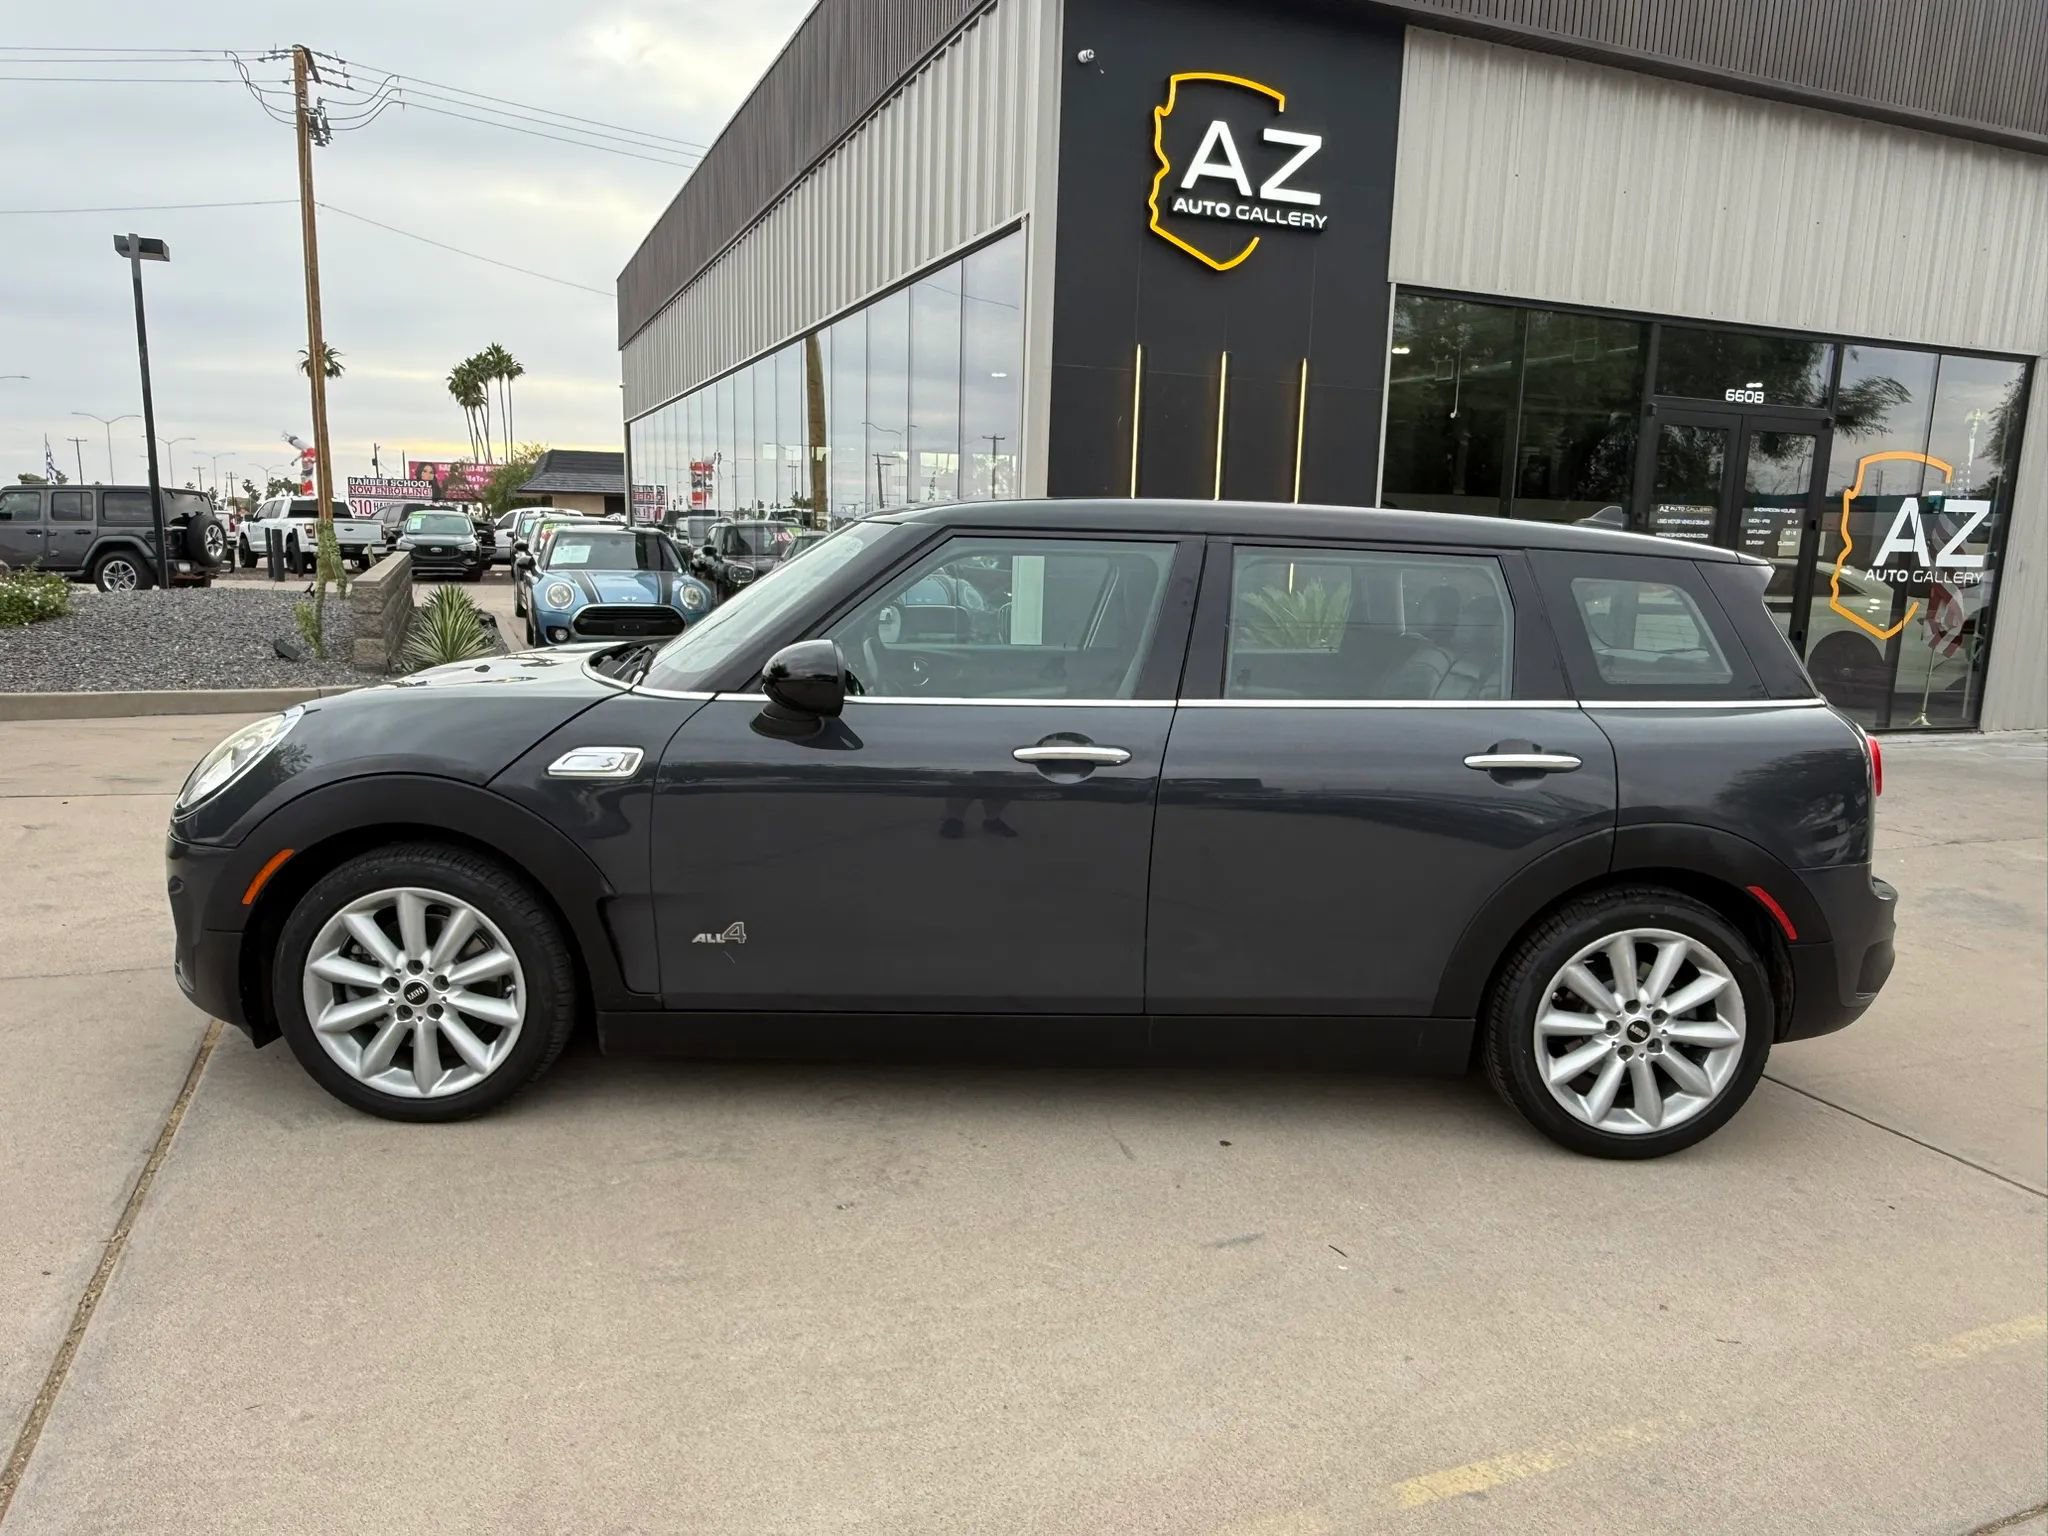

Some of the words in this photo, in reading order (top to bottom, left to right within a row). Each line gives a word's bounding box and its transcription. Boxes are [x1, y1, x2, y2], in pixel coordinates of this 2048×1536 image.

[1180, 120, 1322, 206] AZ
[1173, 198, 1231, 217] AUTO
[1235, 205, 1328, 229] GALLERY
[1725, 388, 1765, 403] 6608
[349, 478, 389, 486] BARBER
[390, 480, 432, 488] SCHOOL
[350, 486, 373, 495] NOW
[350, 500, 372, 515] $10
[1659, 505, 1669, 513] AZ
[1872, 497, 1991, 568] AZ
[1864, 568, 1909, 583] AUTO
[1912, 570, 1985, 584] GALLERY
[406, 986, 426, 1001] MINI
